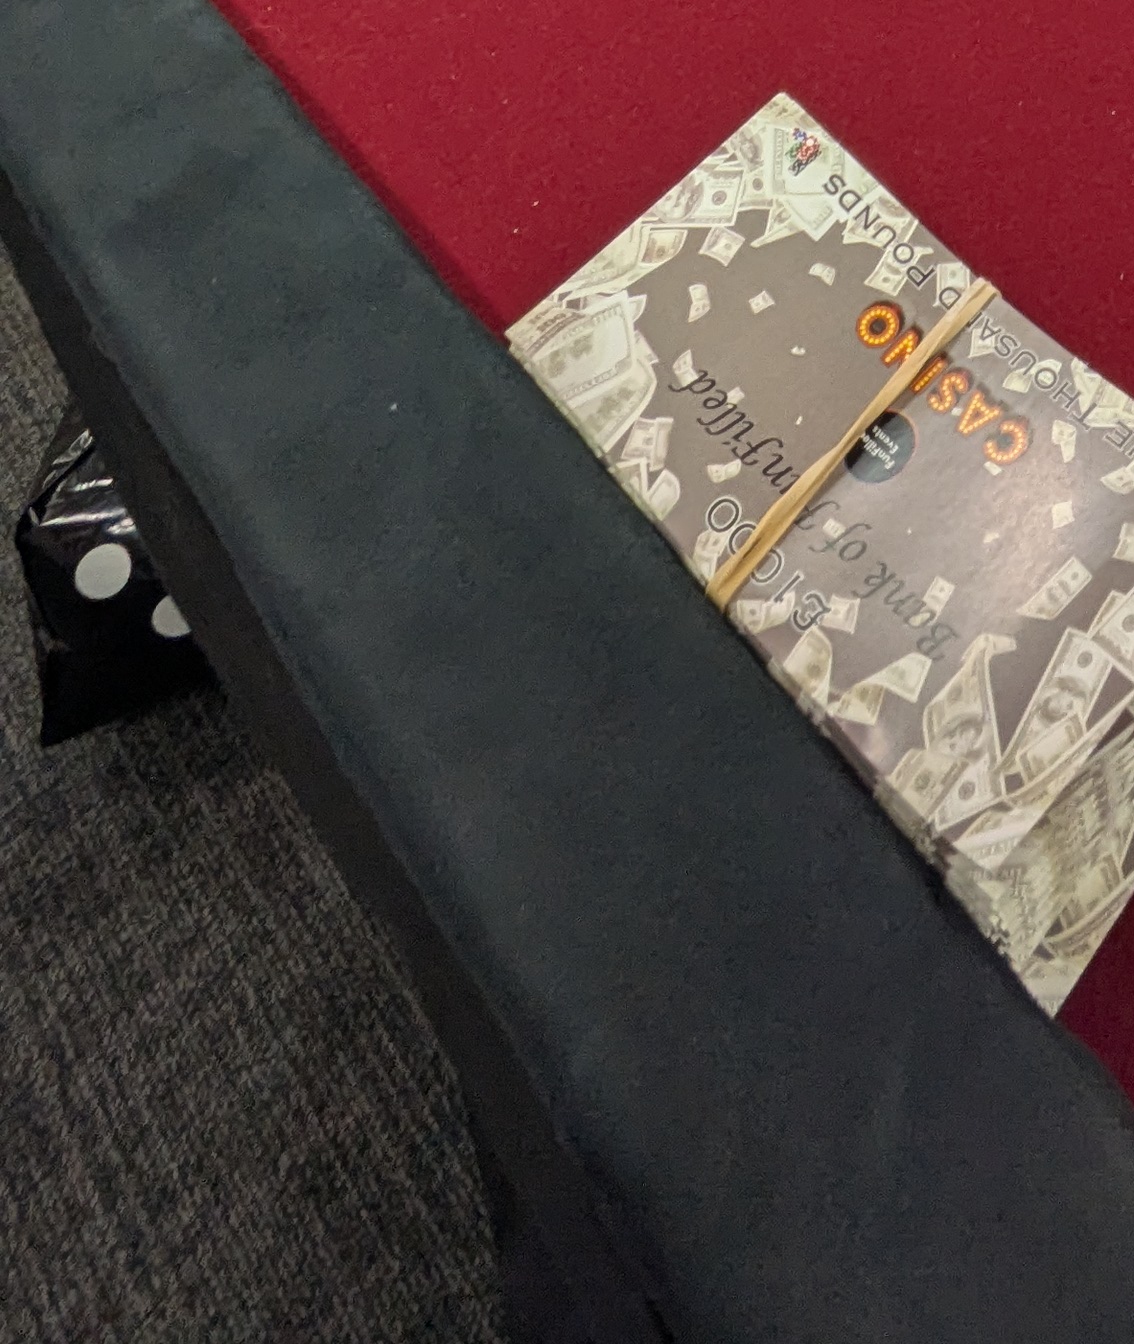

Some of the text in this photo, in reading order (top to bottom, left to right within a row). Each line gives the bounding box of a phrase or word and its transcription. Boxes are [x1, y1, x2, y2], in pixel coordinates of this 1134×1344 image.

[822, 174, 936, 289] POUNDS
[856, 301, 1030, 465] CASINO
[937, 286, 1100, 430] THOUSAD
[872, 425, 899, 454] Events
[808, 522, 872, 561] of
[853, 561, 958, 661] Bank
